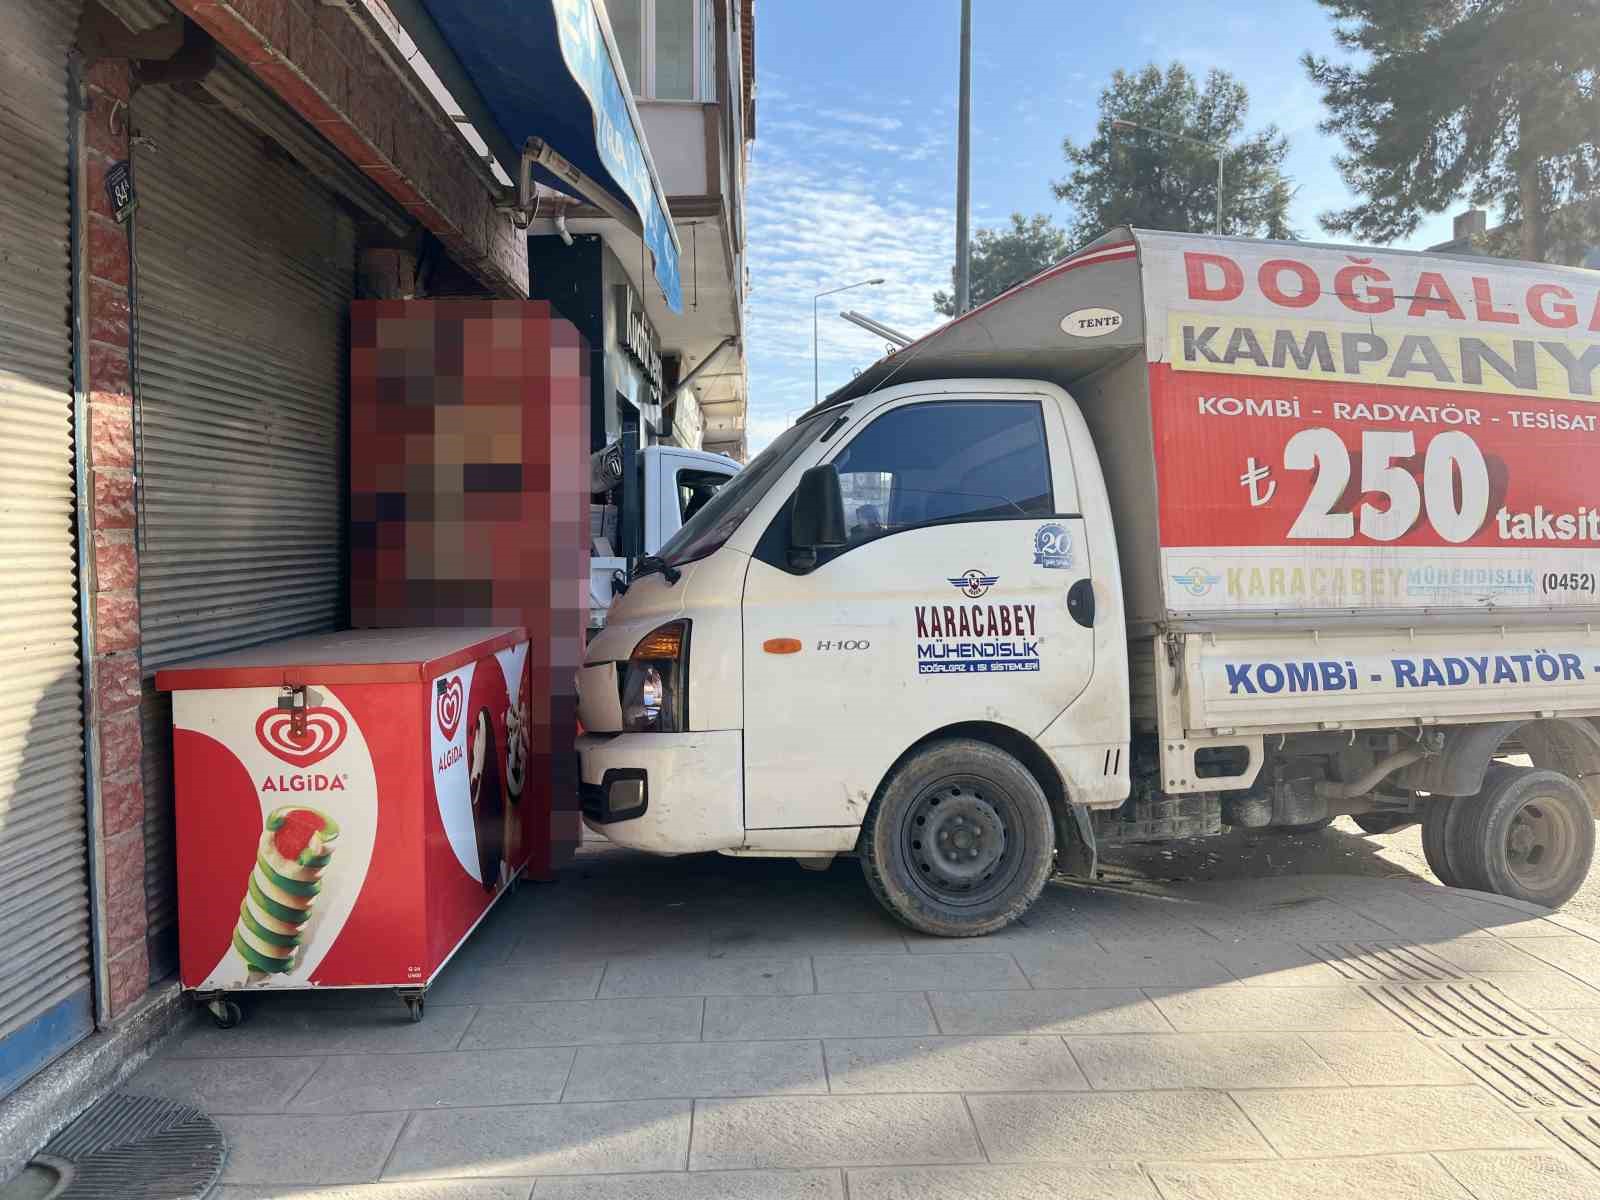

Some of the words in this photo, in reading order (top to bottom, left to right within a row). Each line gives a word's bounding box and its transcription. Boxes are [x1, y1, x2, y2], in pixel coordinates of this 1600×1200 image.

[1183, 251, 1600, 332] DOĞALG
[1078, 316, 1120, 329] TENTE
[1182, 324, 1600, 396] KAMPANY
[1197, 395, 1301, 418] KOMBİ
[1333, 402, 1481, 425] RADYATÖR
[1507, 408, 1598, 432] TESİSAT
[1283, 427, 1490, 543] 250
[1496, 504, 1600, 541] taksit
[1041, 531, 1072, 554] 20
[1227, 567, 1405, 596] KARACABEY
[1542, 572, 1596, 595] (0452)
[915, 605, 1035, 638] KARACABEY
[816, 639, 870, 652] H-100
[917, 637, 1039, 659] MÜHENDİSLİK
[1391, 648, 1585, 688] RADYATÖR
